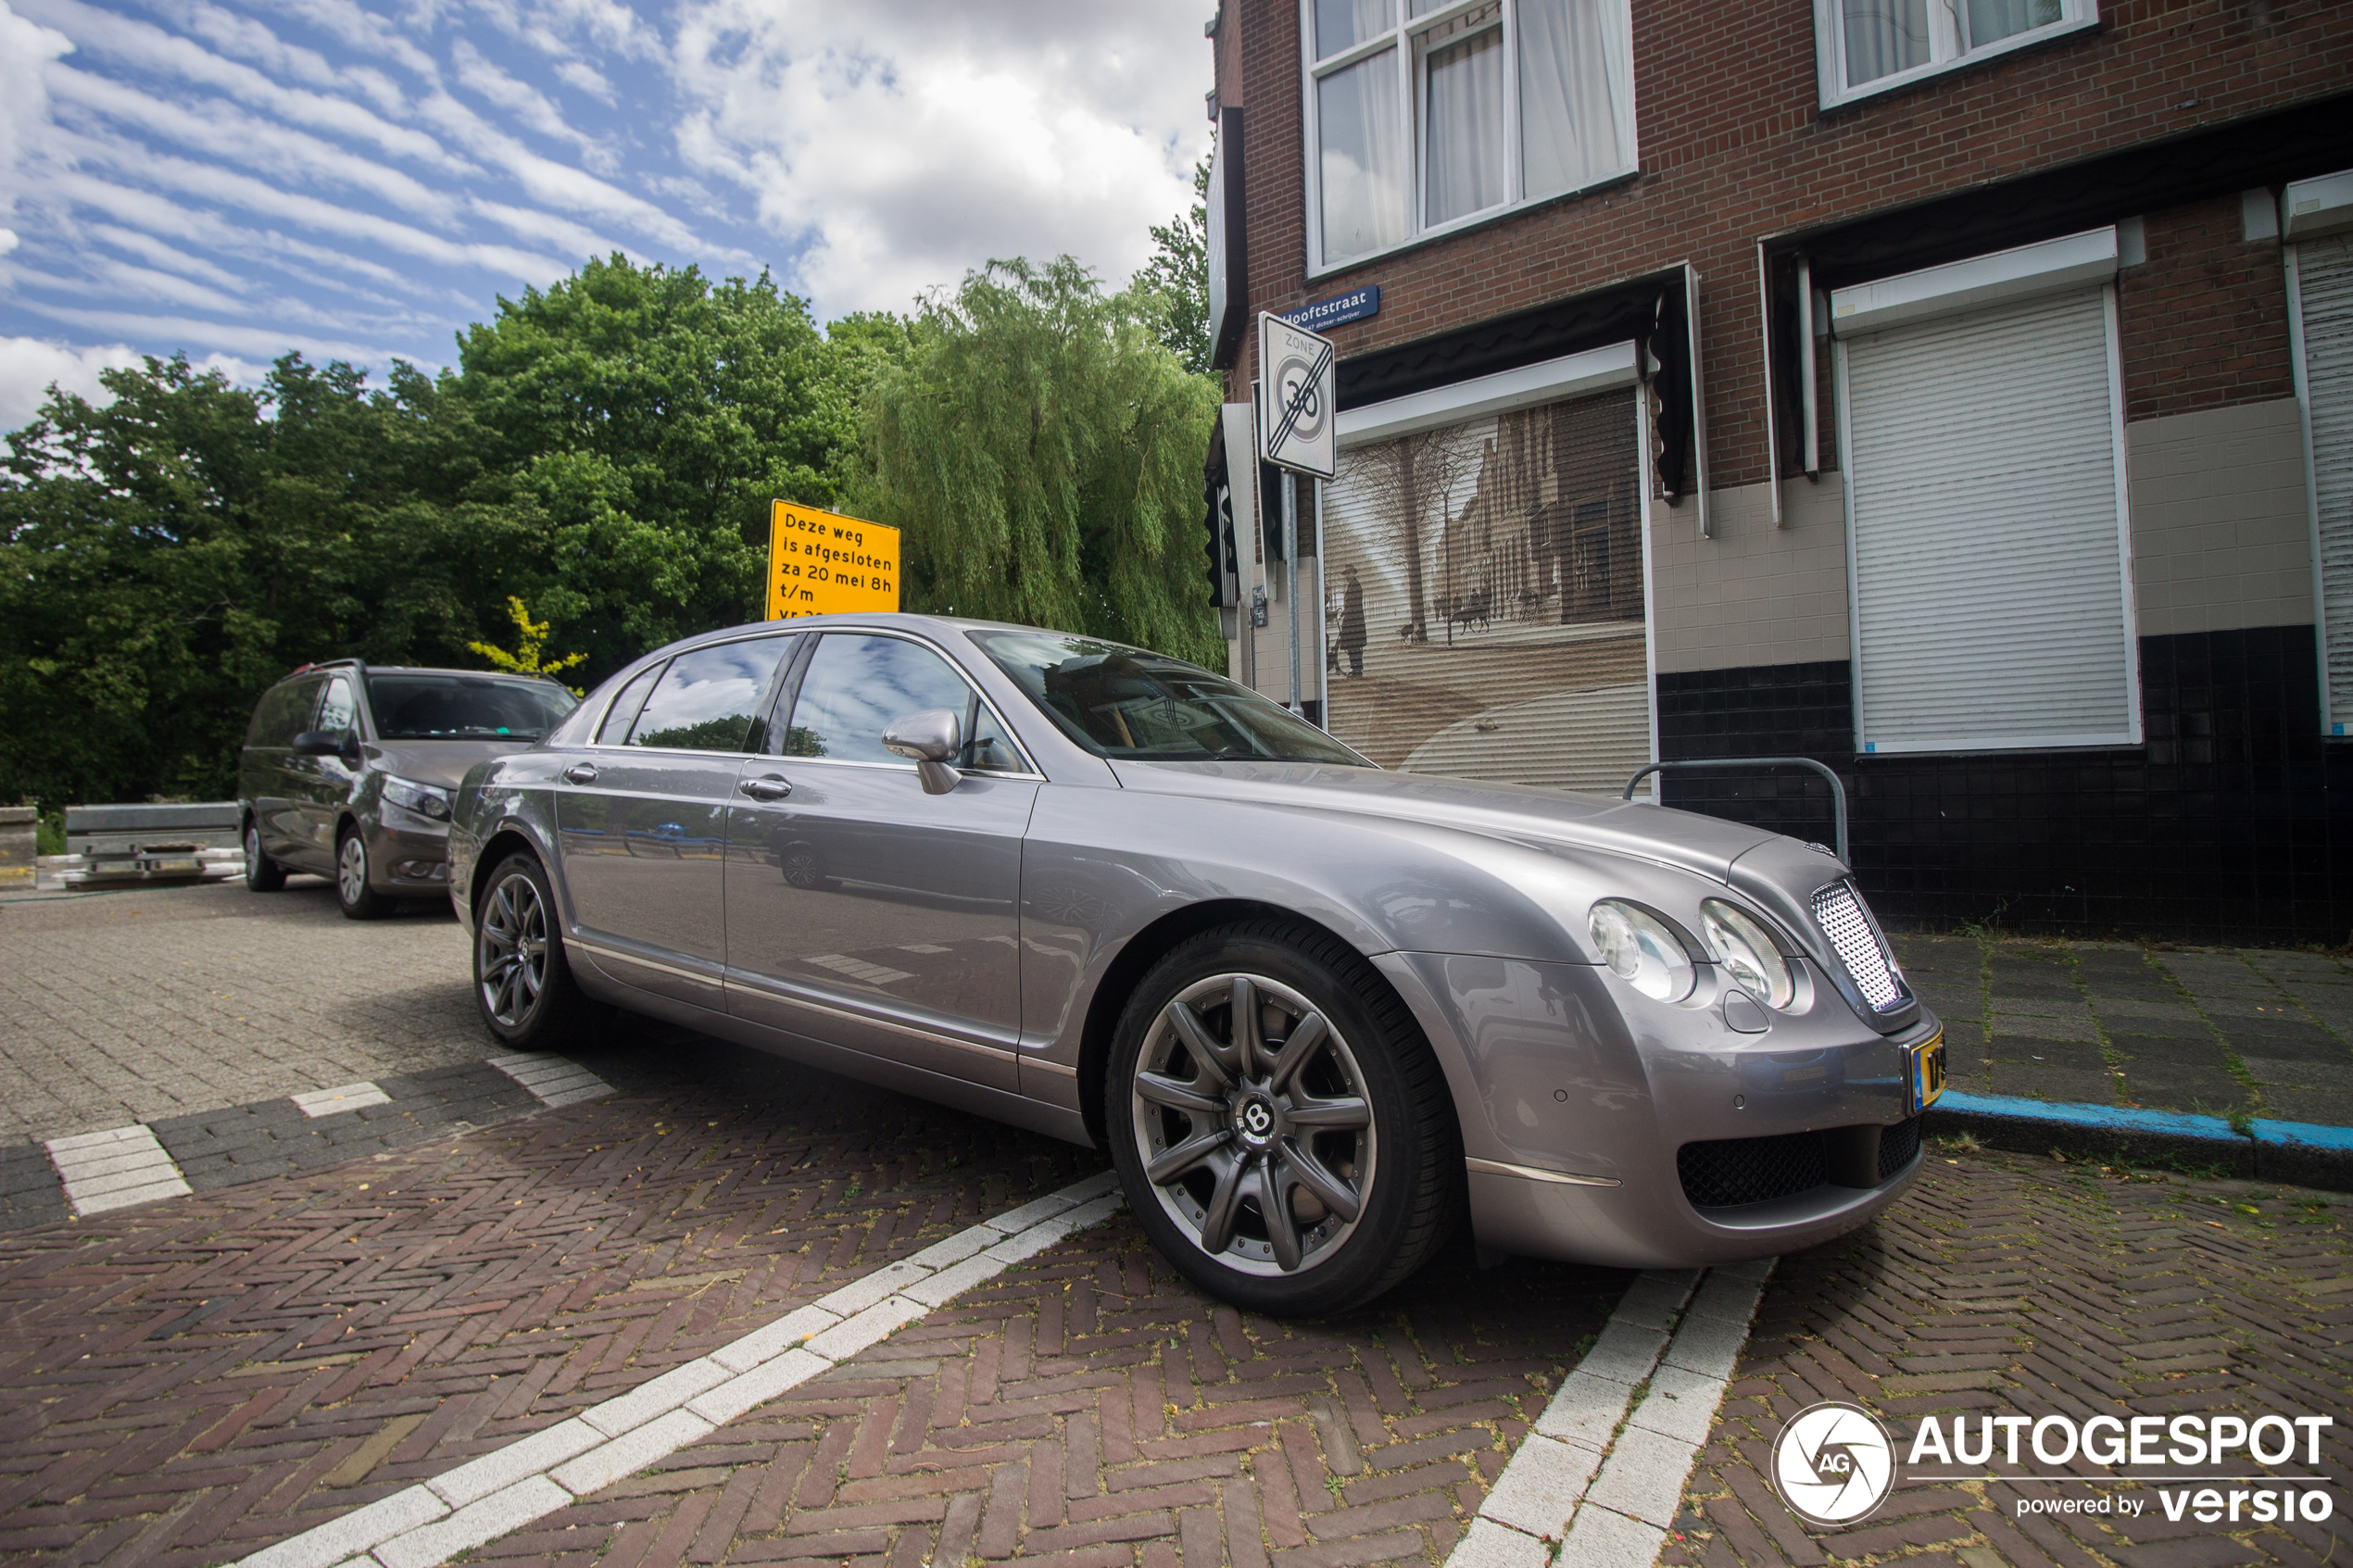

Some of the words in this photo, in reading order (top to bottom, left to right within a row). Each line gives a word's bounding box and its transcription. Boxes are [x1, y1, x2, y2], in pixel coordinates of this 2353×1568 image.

[1283, 293, 1366, 324] Hooftstraat
[1285, 332, 1315, 356] ZONE
[1286, 380, 1318, 418] 30
[786, 513, 826, 534] Deze
[833, 527, 862, 547] weg
[784, 537, 798, 553] is
[805, 544, 891, 571] afgesloten
[780, 583, 813, 602] t/m
[781, 562, 800, 576] za
[808, 565, 829, 582] 20
[836, 572, 864, 588] mei
[871, 577, 891, 593] 8h
[1246, 1103, 1270, 1132] B
